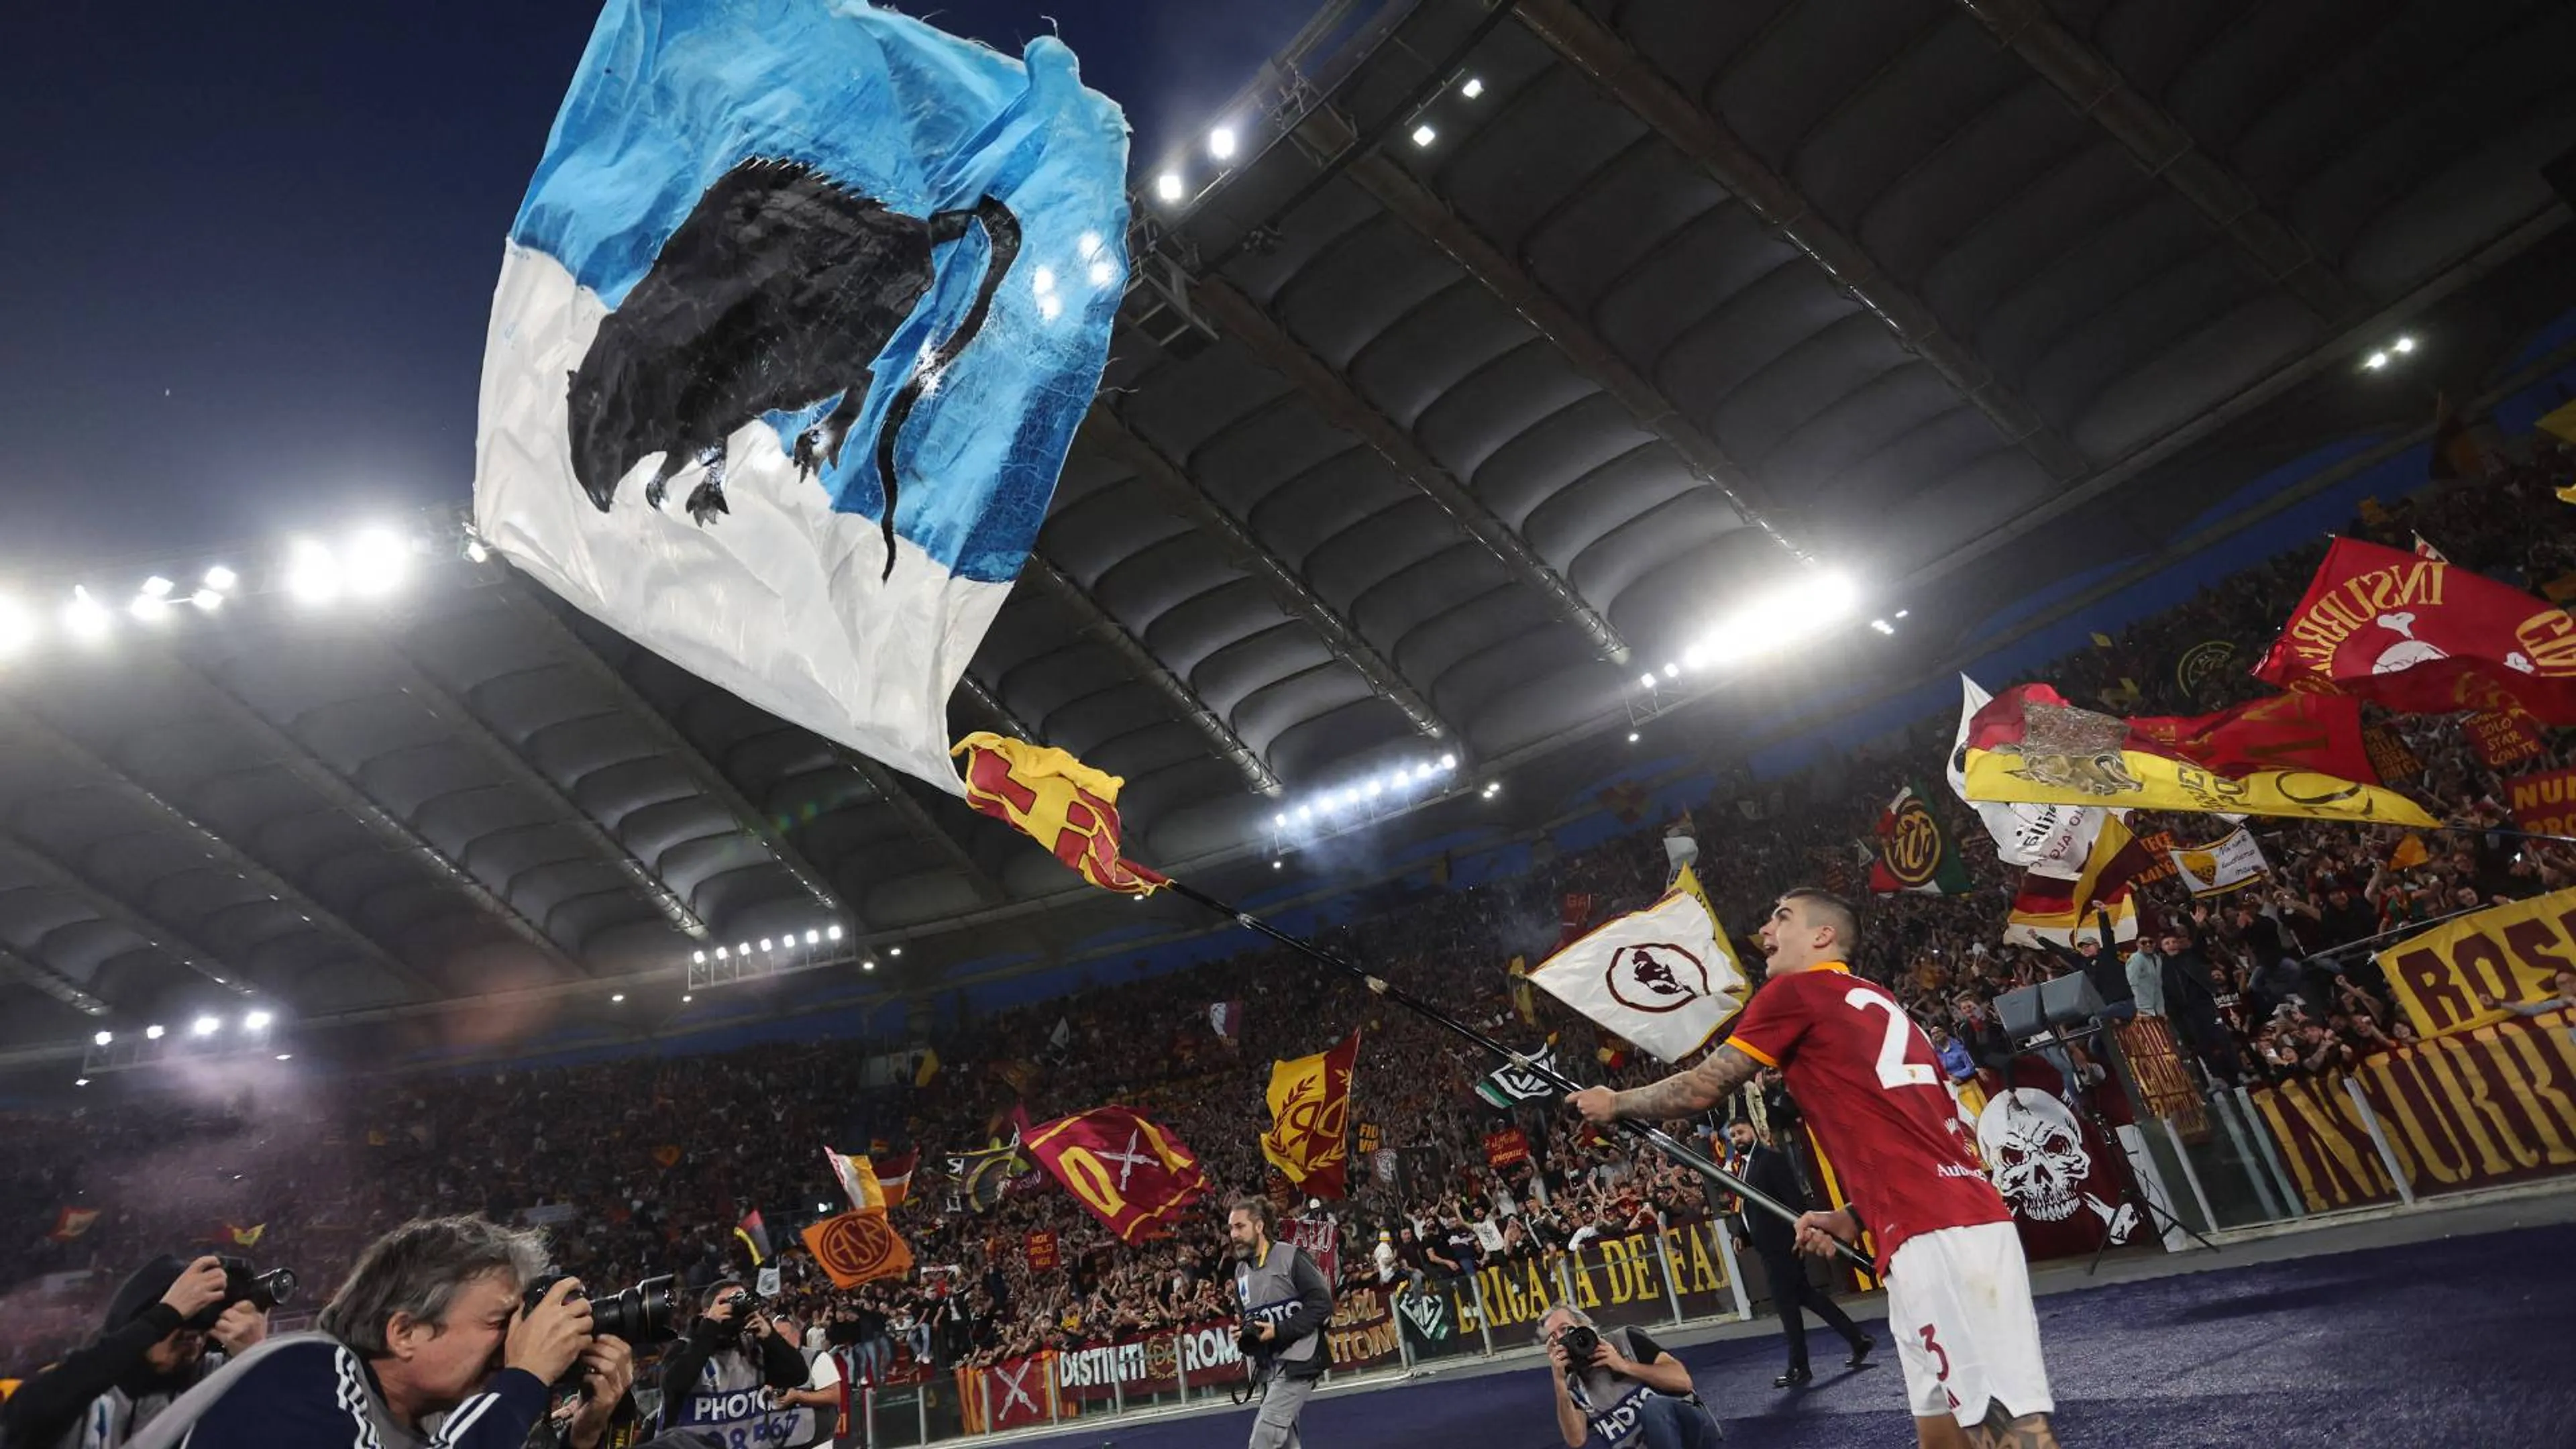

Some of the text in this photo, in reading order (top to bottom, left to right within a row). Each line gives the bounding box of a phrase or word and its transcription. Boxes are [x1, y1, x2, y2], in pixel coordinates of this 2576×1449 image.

[2396, 908, 2576, 1030] ROS
[1599, 1234, 1659, 1305] DE
[1183, 1326, 1241, 1371] ROM
